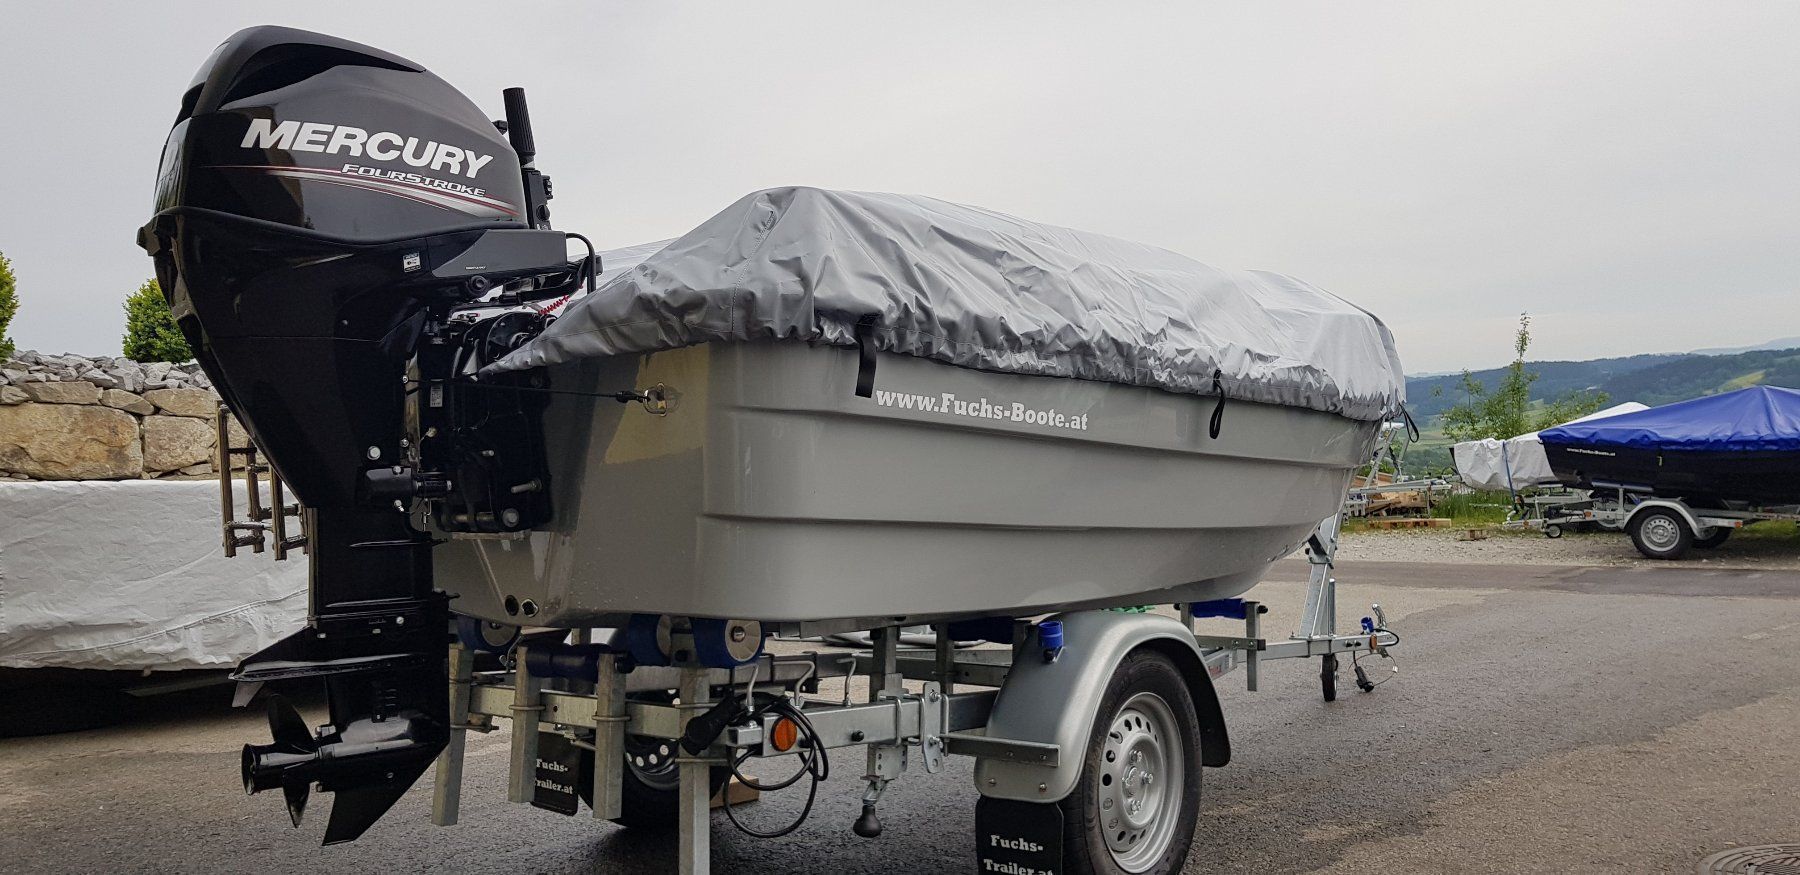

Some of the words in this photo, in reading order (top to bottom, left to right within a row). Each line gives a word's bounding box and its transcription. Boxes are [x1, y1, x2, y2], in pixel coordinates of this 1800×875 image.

[241, 118, 493, 179] MERCURY
[341, 163, 486, 197] FOURSTROKE
[876, 388, 1089, 431] www.Fuchs-Boote.at
[536, 758, 569, 772] Fuchs-
[990, 834, 1044, 852] Fuchs-
[983, 858, 1054, 875] Trailerat
